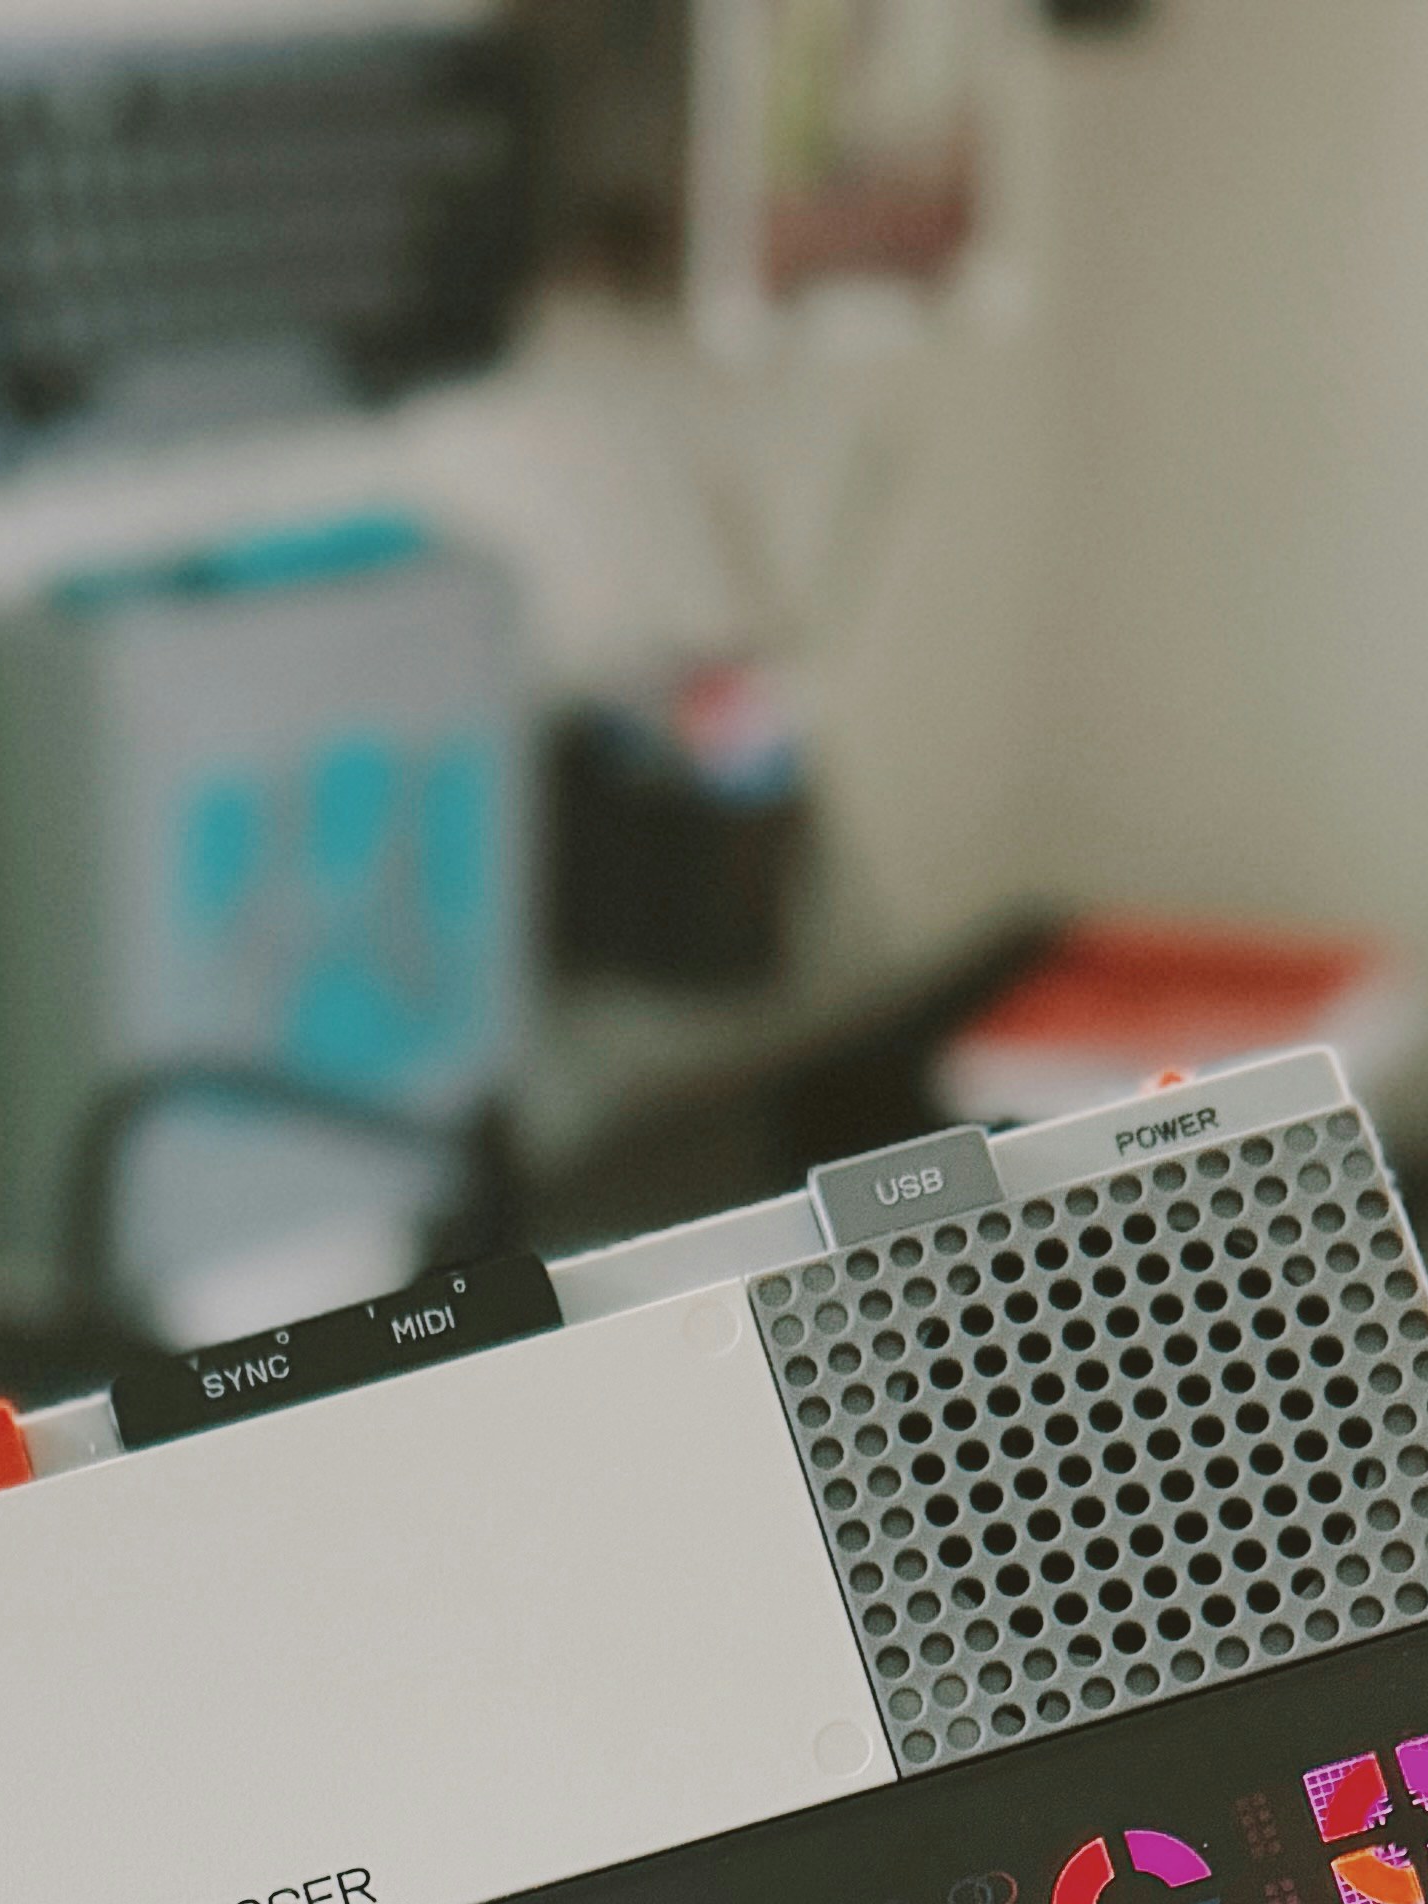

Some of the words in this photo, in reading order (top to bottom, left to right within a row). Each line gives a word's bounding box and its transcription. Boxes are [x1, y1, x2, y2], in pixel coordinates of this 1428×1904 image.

[1113, 1106, 1219, 1157] POWER
[876, 1168, 944, 1206] USB
[392, 1305, 457, 1345] MIDI
[202, 1354, 291, 1400] SYNC
